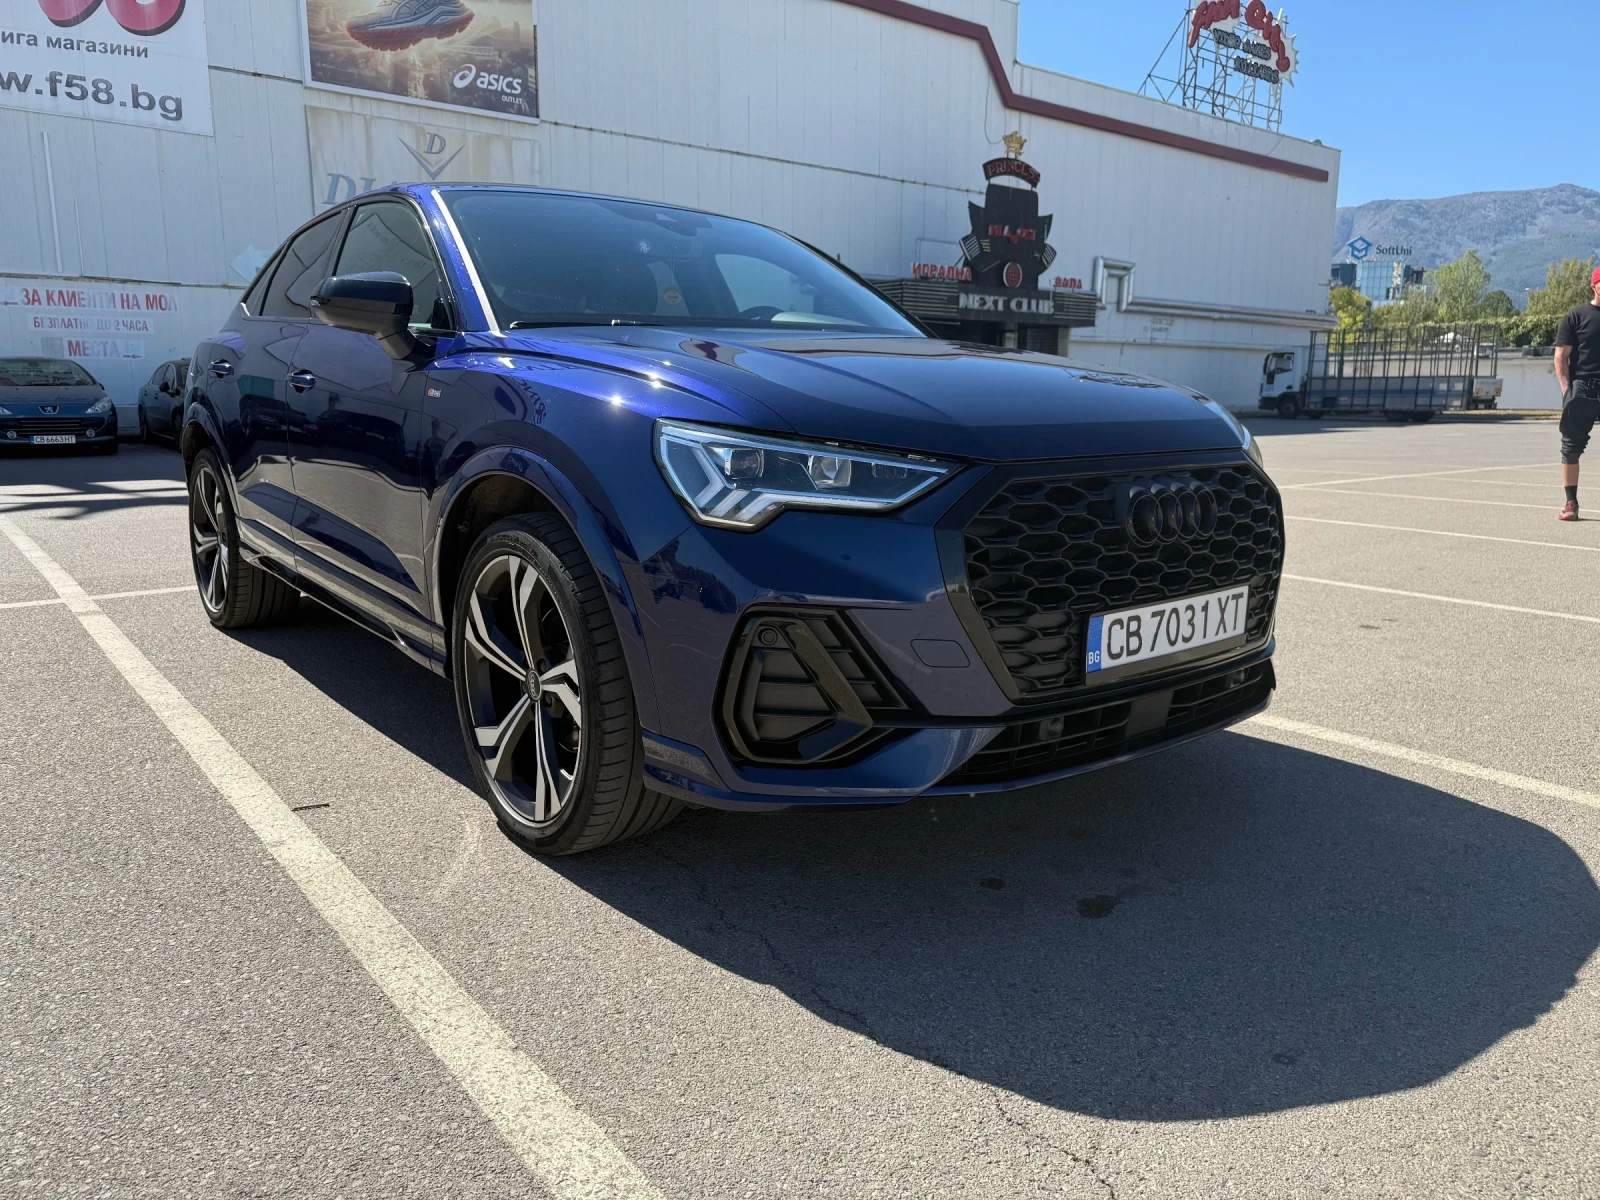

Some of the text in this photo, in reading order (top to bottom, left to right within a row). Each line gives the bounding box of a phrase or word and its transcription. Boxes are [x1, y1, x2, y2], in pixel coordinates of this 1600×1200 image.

[46, 35, 148, 58] магазини
[501, 95, 523, 104] OUTLET
[423, 132, 446, 154] D
[1375, 244, 1413, 255] SoftUni
[21, 287, 178, 311] ЗА КЛИЕНТИ НА МОЛ
[958, 293, 1054, 315] NEXT CLUB
[33, 316, 149, 332] БЕЗПЛАТНО ДО 2 ЧАСА
[1088, 650, 1100, 664] BG
